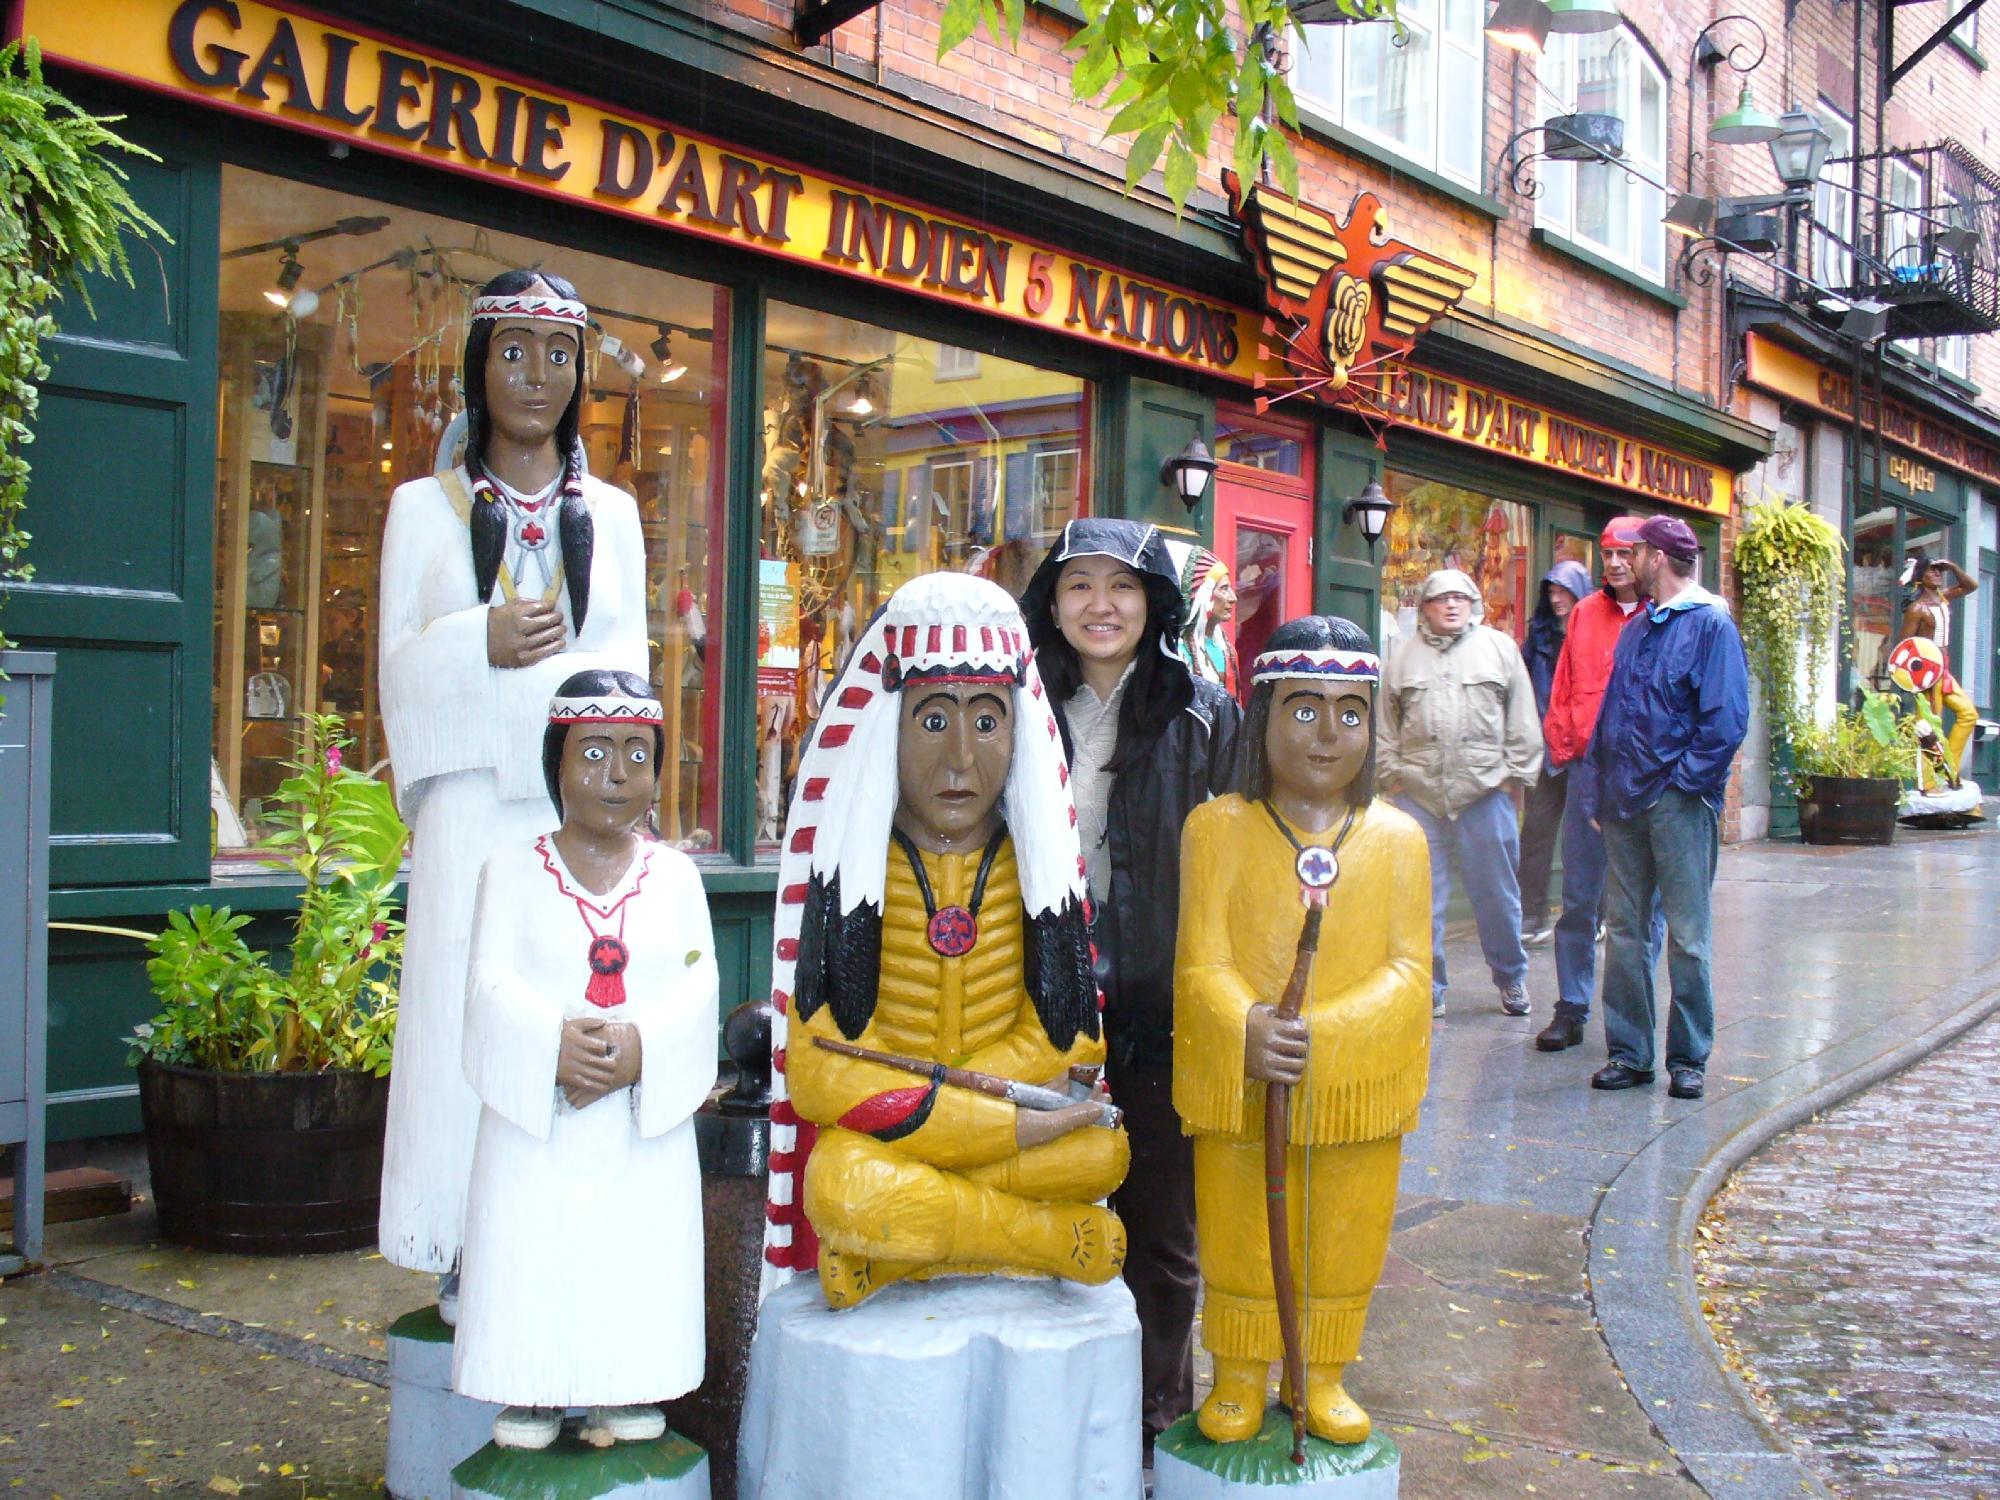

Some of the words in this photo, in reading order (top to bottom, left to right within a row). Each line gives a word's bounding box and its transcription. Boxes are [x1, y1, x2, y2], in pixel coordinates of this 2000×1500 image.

[167, 0, 571, 181] GALERIE
[594, 119, 804, 243] D'ART
[823, 189, 1014, 303] INDIEN
[1023, 251, 1057, 315] 5
[1065, 262, 1240, 368] NATIONS
[1463, 388, 1542, 454] D'ART
[1546, 416, 1622, 478] INDIEN
[1622, 445, 1637, 484] 5
[1639, 446, 1715, 507] NATIONS
